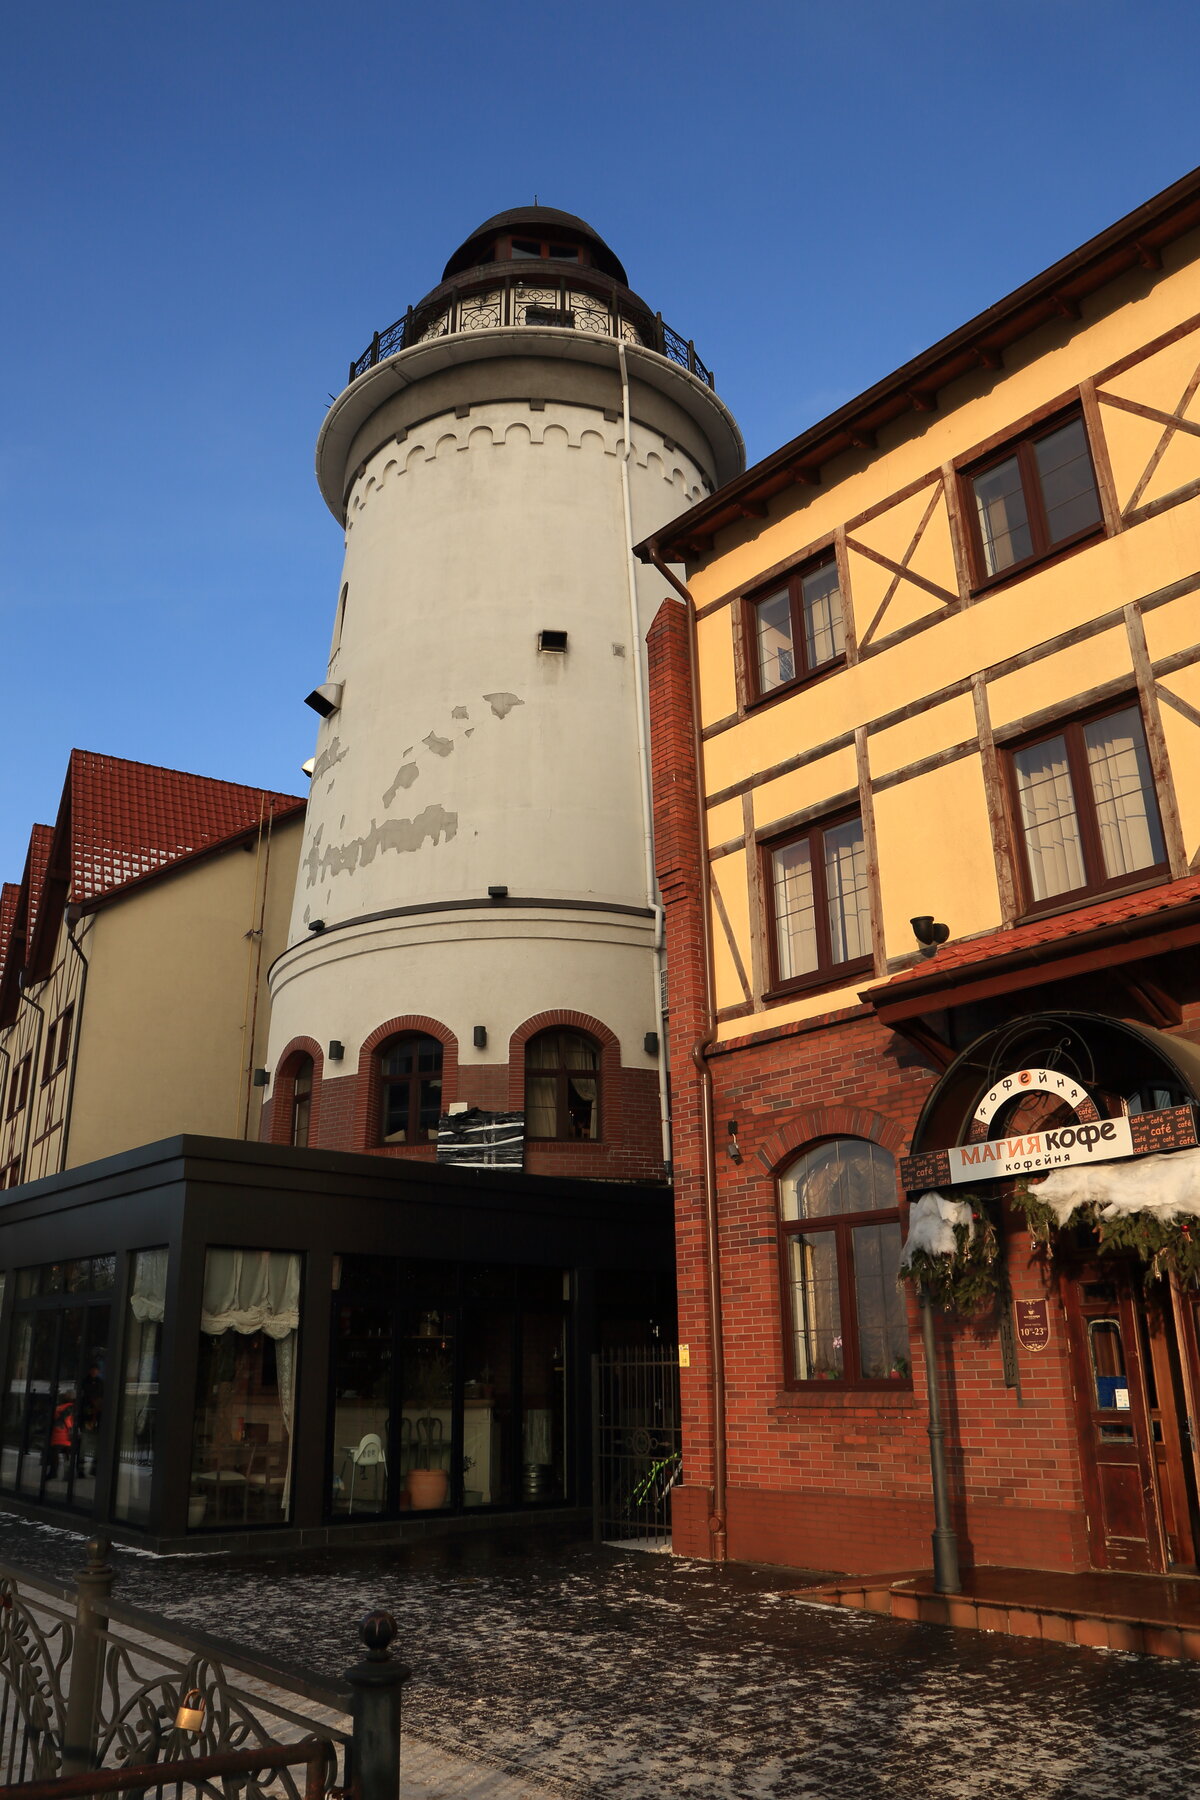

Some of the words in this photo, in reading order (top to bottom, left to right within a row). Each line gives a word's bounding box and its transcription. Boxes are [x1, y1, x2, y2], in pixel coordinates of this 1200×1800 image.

[980, 1071, 1078, 1116] кофейня
[1175, 1106, 1190, 1116] café
[1131, 1115, 1145, 1124] café
[1151, 1116, 1164, 1125] café
[1151, 1123, 1171, 1136] café
[960, 1135, 1042, 1166] МАГИЯ
[1005, 1153, 1071, 1171] кофейня
[916, 1165, 933, 1177] café
